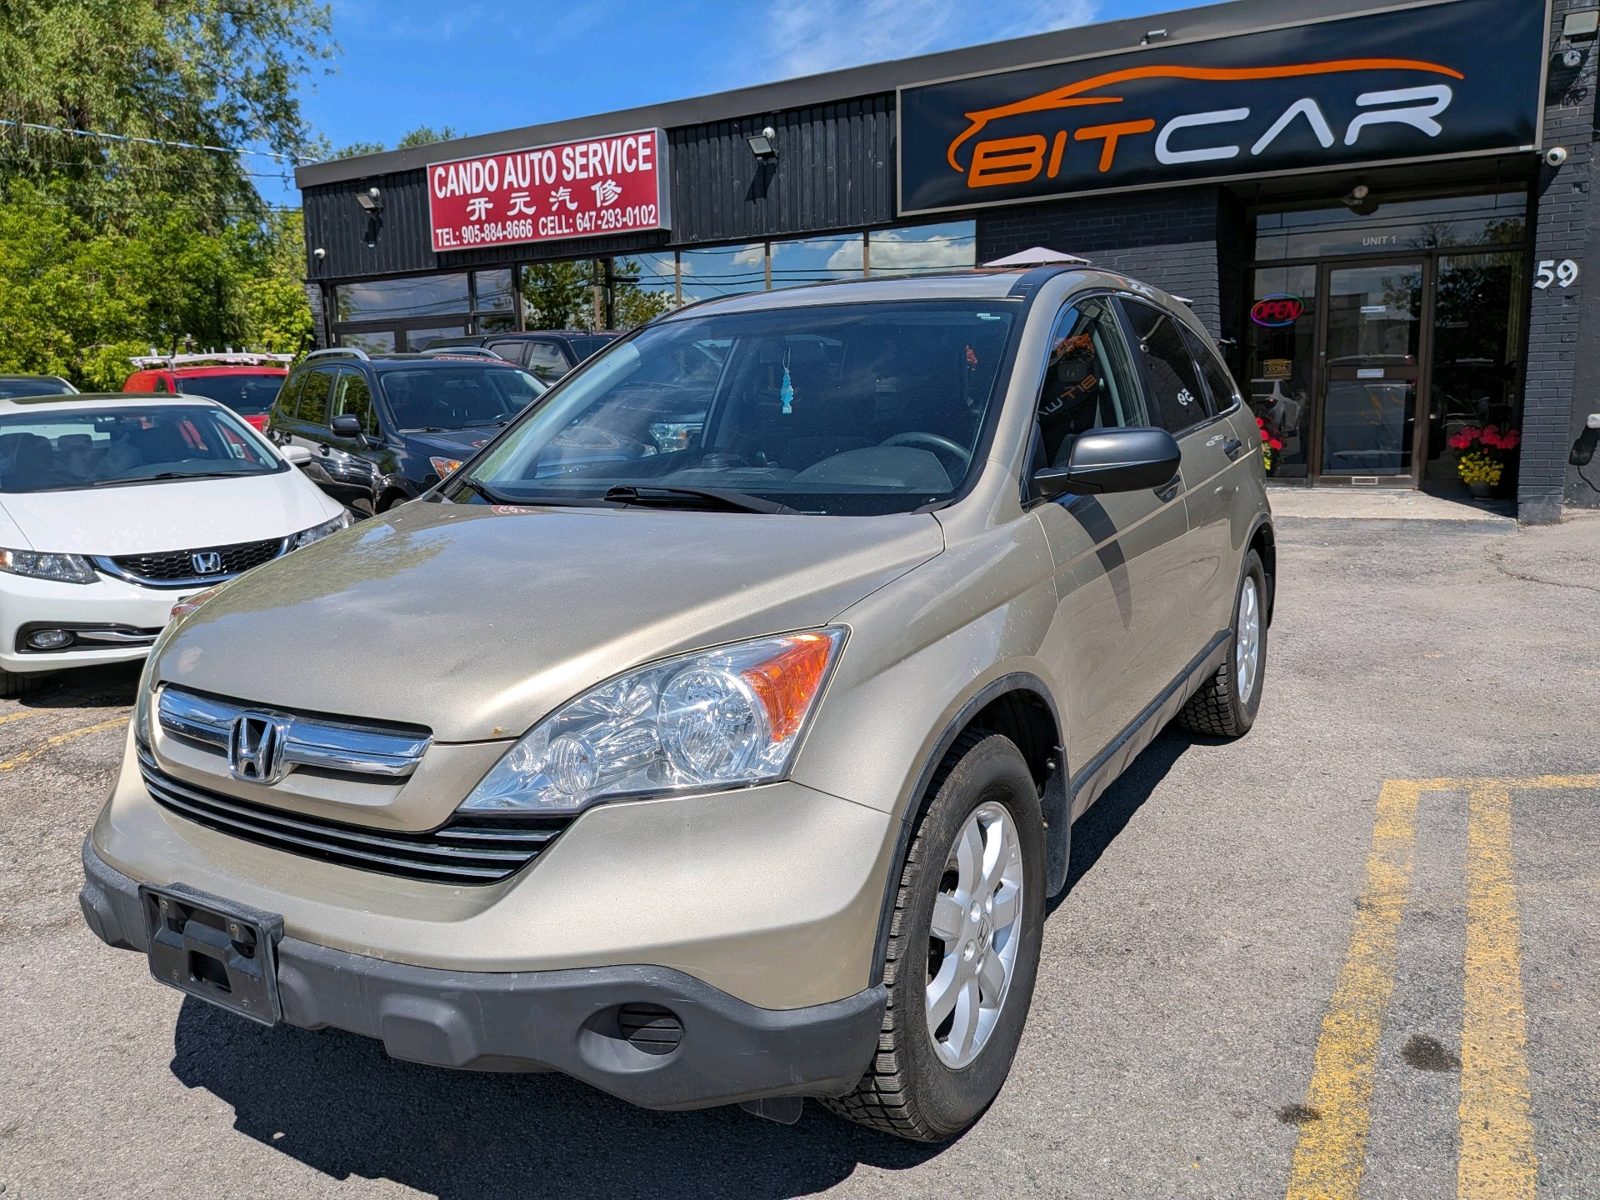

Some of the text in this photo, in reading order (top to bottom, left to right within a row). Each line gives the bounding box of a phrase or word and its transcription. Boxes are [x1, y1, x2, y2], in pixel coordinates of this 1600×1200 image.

[433, 134, 653, 199] CANDO AUTO SERVICE
[466, 179, 623, 222] 开元汽修
[435, 204, 657, 247] TEL: 905-884-8666 CELL: 647-293-0102
[1362, 234, 1396, 246] UNIT 1
[1534, 259, 1578, 289] 59
[1254, 301, 1300, 319] OPEN
